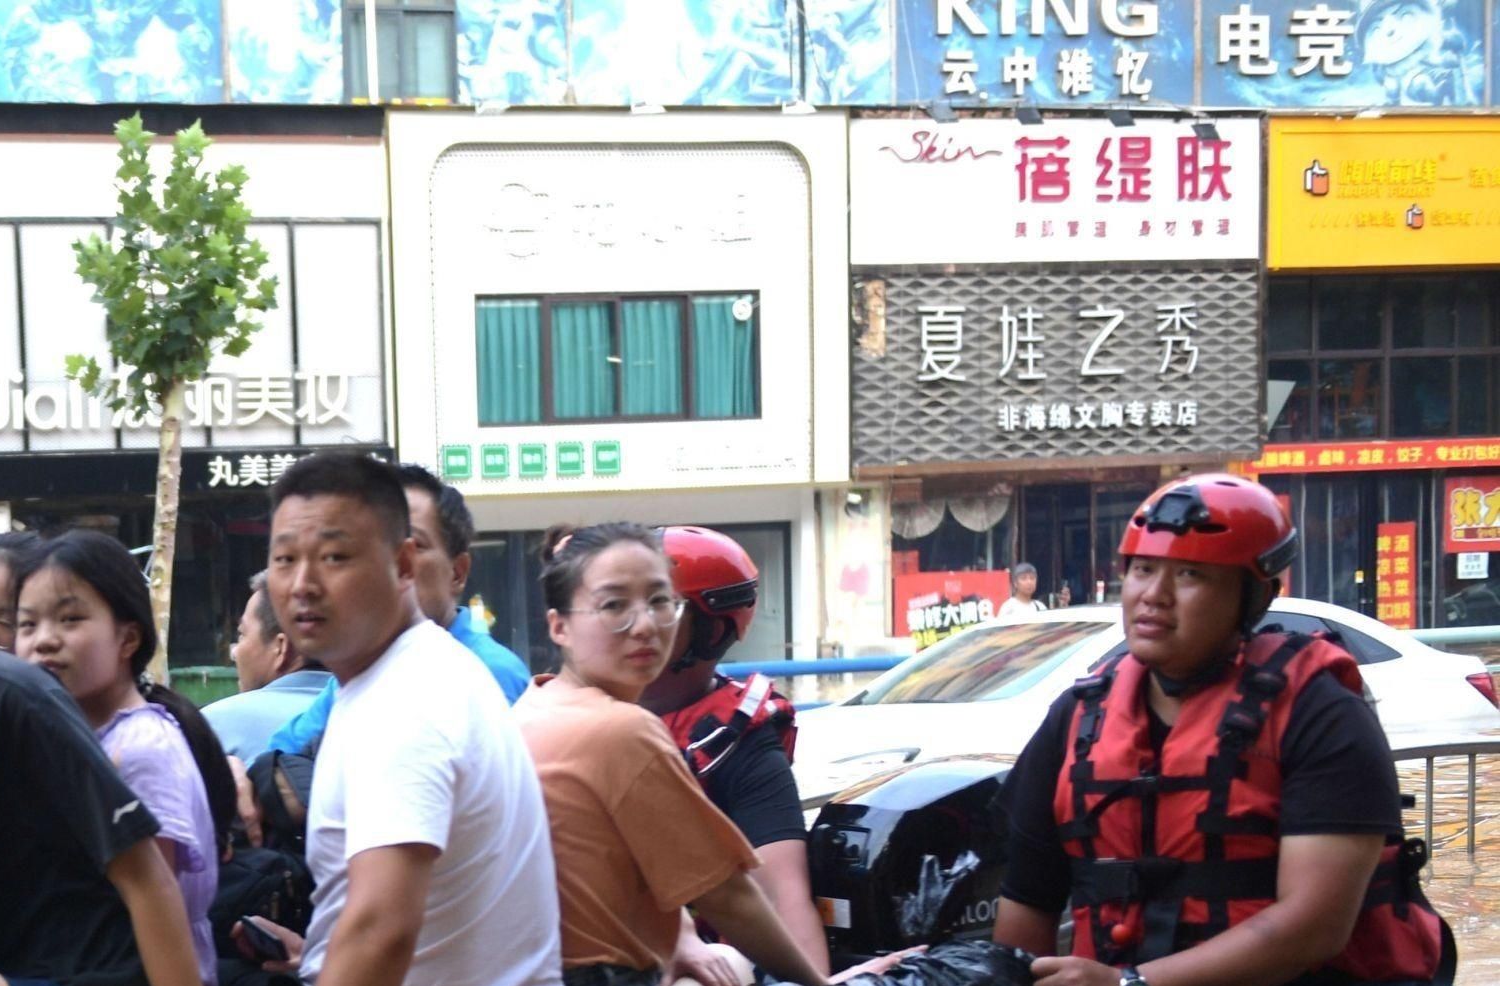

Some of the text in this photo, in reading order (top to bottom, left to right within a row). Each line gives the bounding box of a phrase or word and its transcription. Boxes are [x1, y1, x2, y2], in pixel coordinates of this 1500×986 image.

[1218, 3, 1355, 76] 电竞
[1014, 135, 1232, 203] 蓓缇肤
[918, 303, 1199, 381] 夏娃之秀
[998, 401, 1198, 431] 非海绵文胸专卖店
